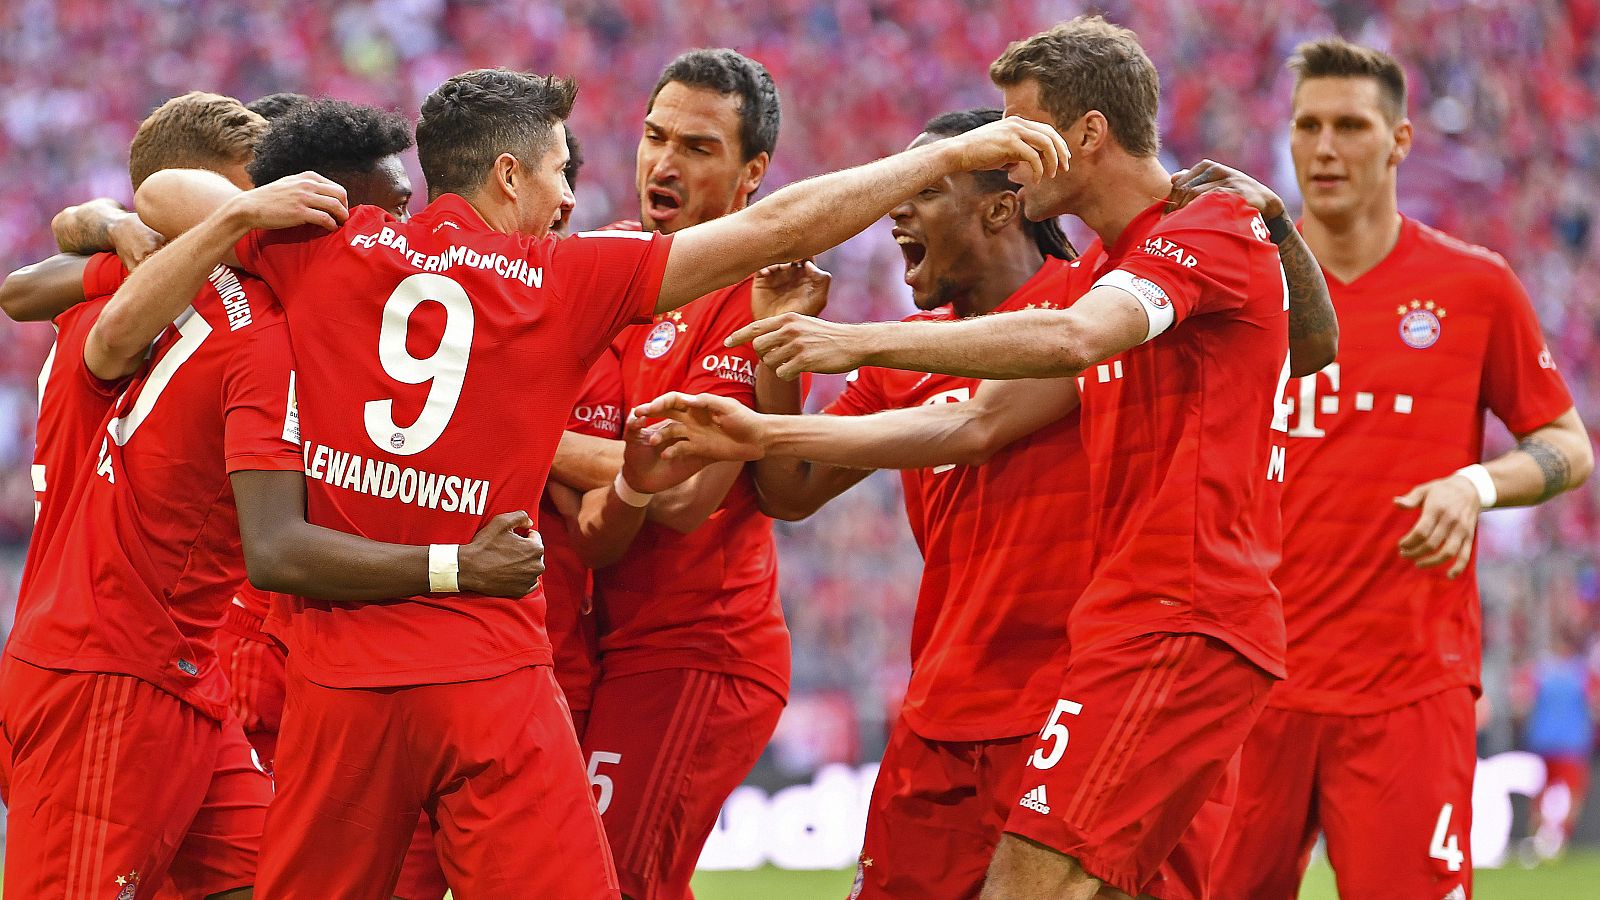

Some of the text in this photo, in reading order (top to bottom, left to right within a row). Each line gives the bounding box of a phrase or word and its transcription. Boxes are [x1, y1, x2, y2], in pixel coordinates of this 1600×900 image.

[350, 233, 379, 249] FC
[377, 226, 450, 272] BAYERN
[364, 272, 474, 456] 9
[702, 354, 756, 377] QATA
[303, 440, 490, 515] LEWANDOWSKI
[1026, 699, 1083, 770] 5
[587, 751, 622, 816] 5
[1019, 797, 1051, 815] adidas
[1429, 802, 1464, 872] 4
